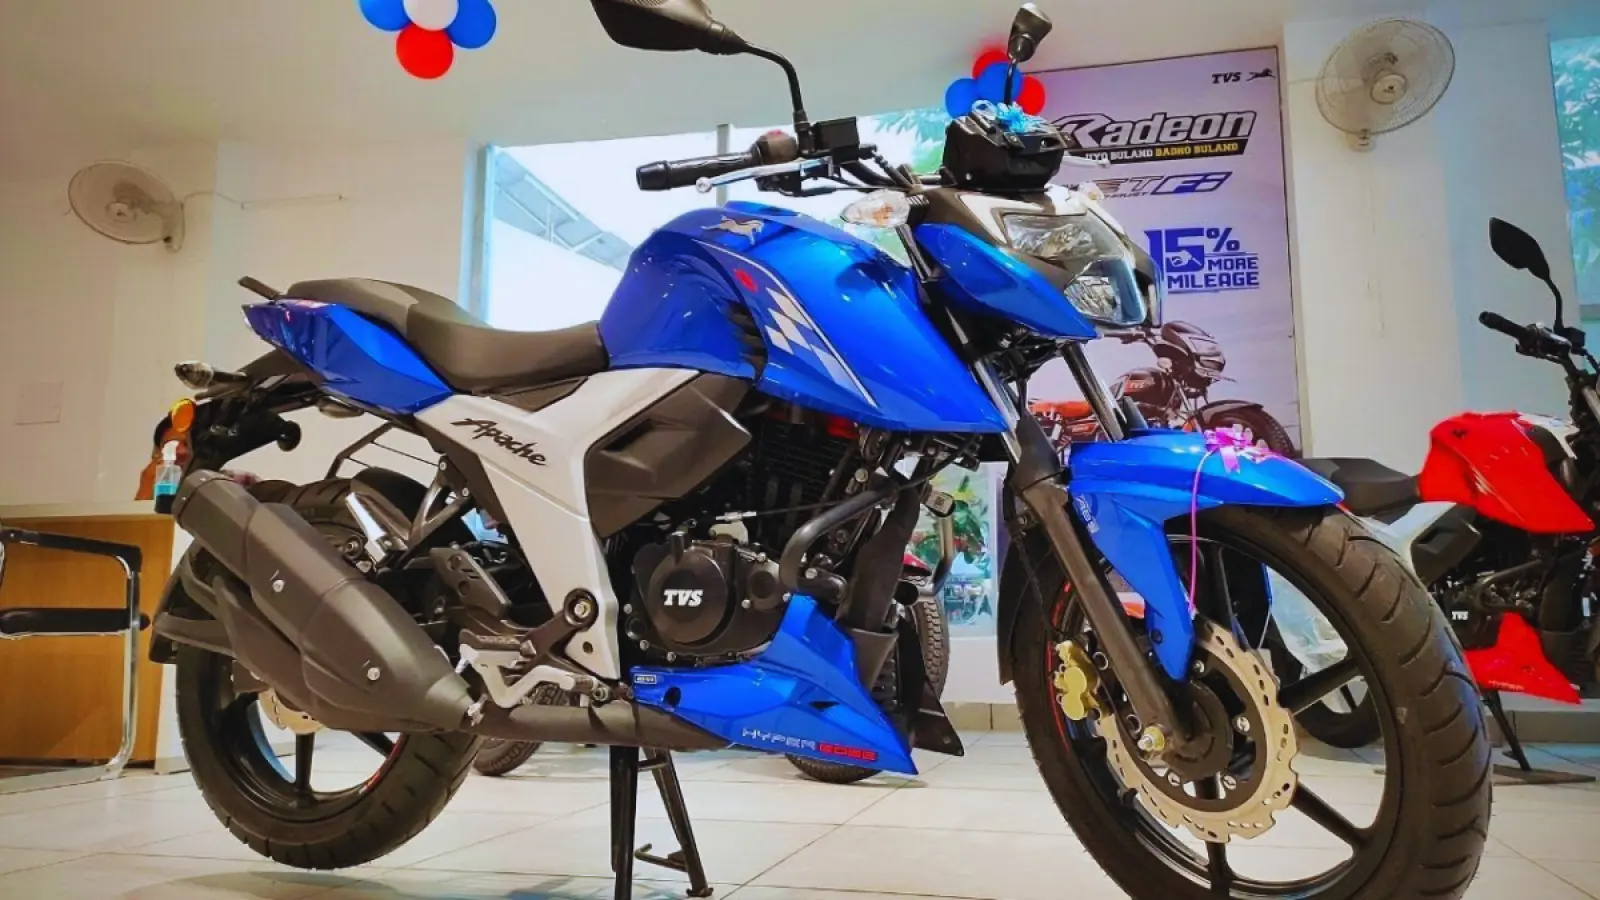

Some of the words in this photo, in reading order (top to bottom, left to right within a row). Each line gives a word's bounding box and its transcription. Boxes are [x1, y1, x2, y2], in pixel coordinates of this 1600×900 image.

[1212, 72, 1241, 84] TVS
[1050, 110, 1257, 149] Radeon
[1110, 149, 1153, 160] BULAND
[1194, 142, 1238, 154] BULAND
[1143, 227, 1240, 281] 15%
[1207, 257, 1259, 271] MORE
[1167, 272, 1259, 289] MILEAGE
[450, 418, 546, 466] Apache
[663, 589, 703, 606] TVS
[1451, 611, 1469, 620] TVS
[742, 727, 817, 751] HYPER
